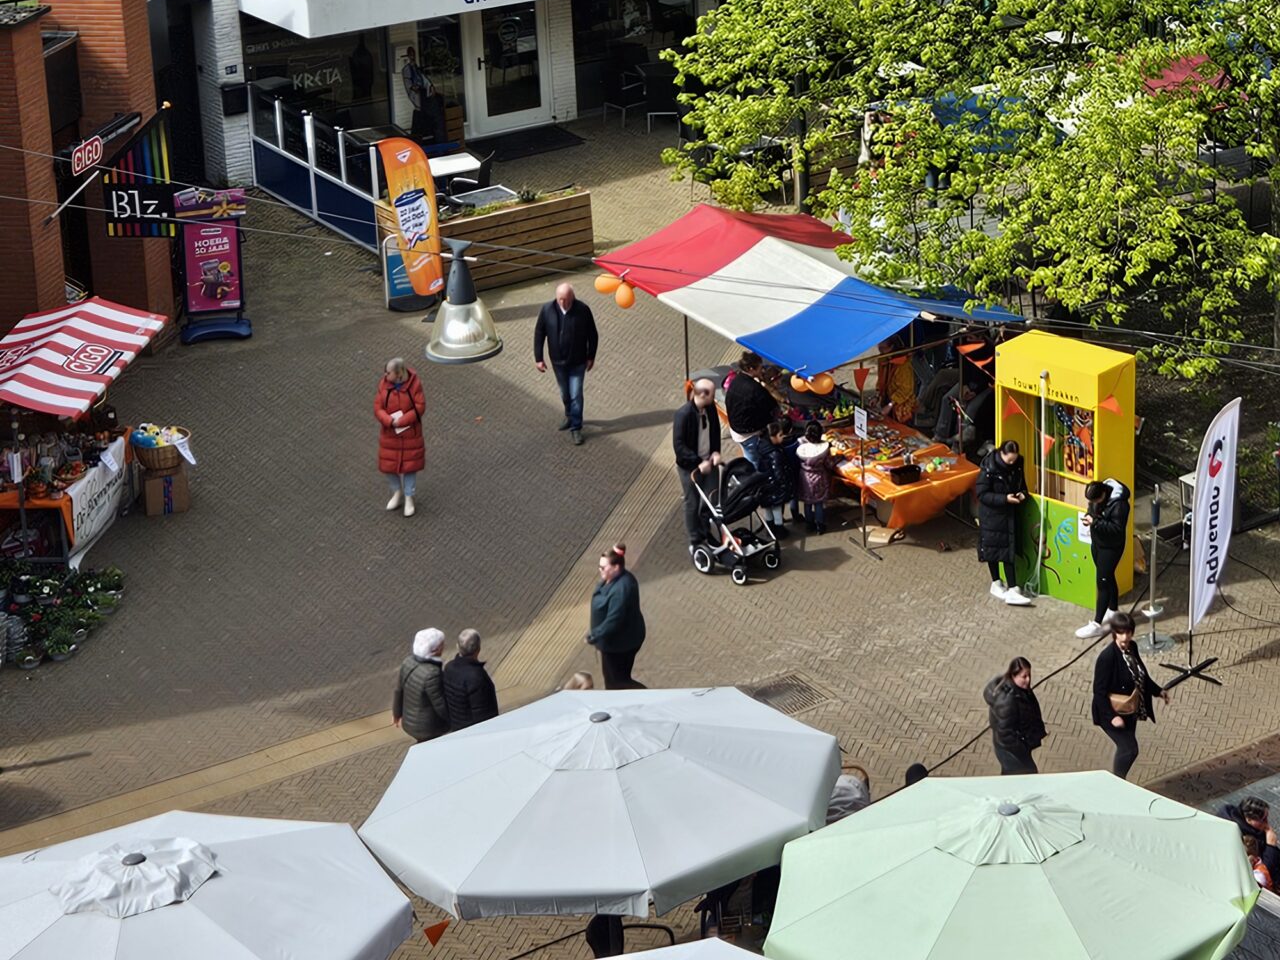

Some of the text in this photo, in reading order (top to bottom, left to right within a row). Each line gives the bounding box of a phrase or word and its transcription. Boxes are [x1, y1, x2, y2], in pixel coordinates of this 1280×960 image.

[292, 67, 343, 90] KRETA
[74, 140, 101, 172] CIGO
[69, 345, 109, 373] CIGO
